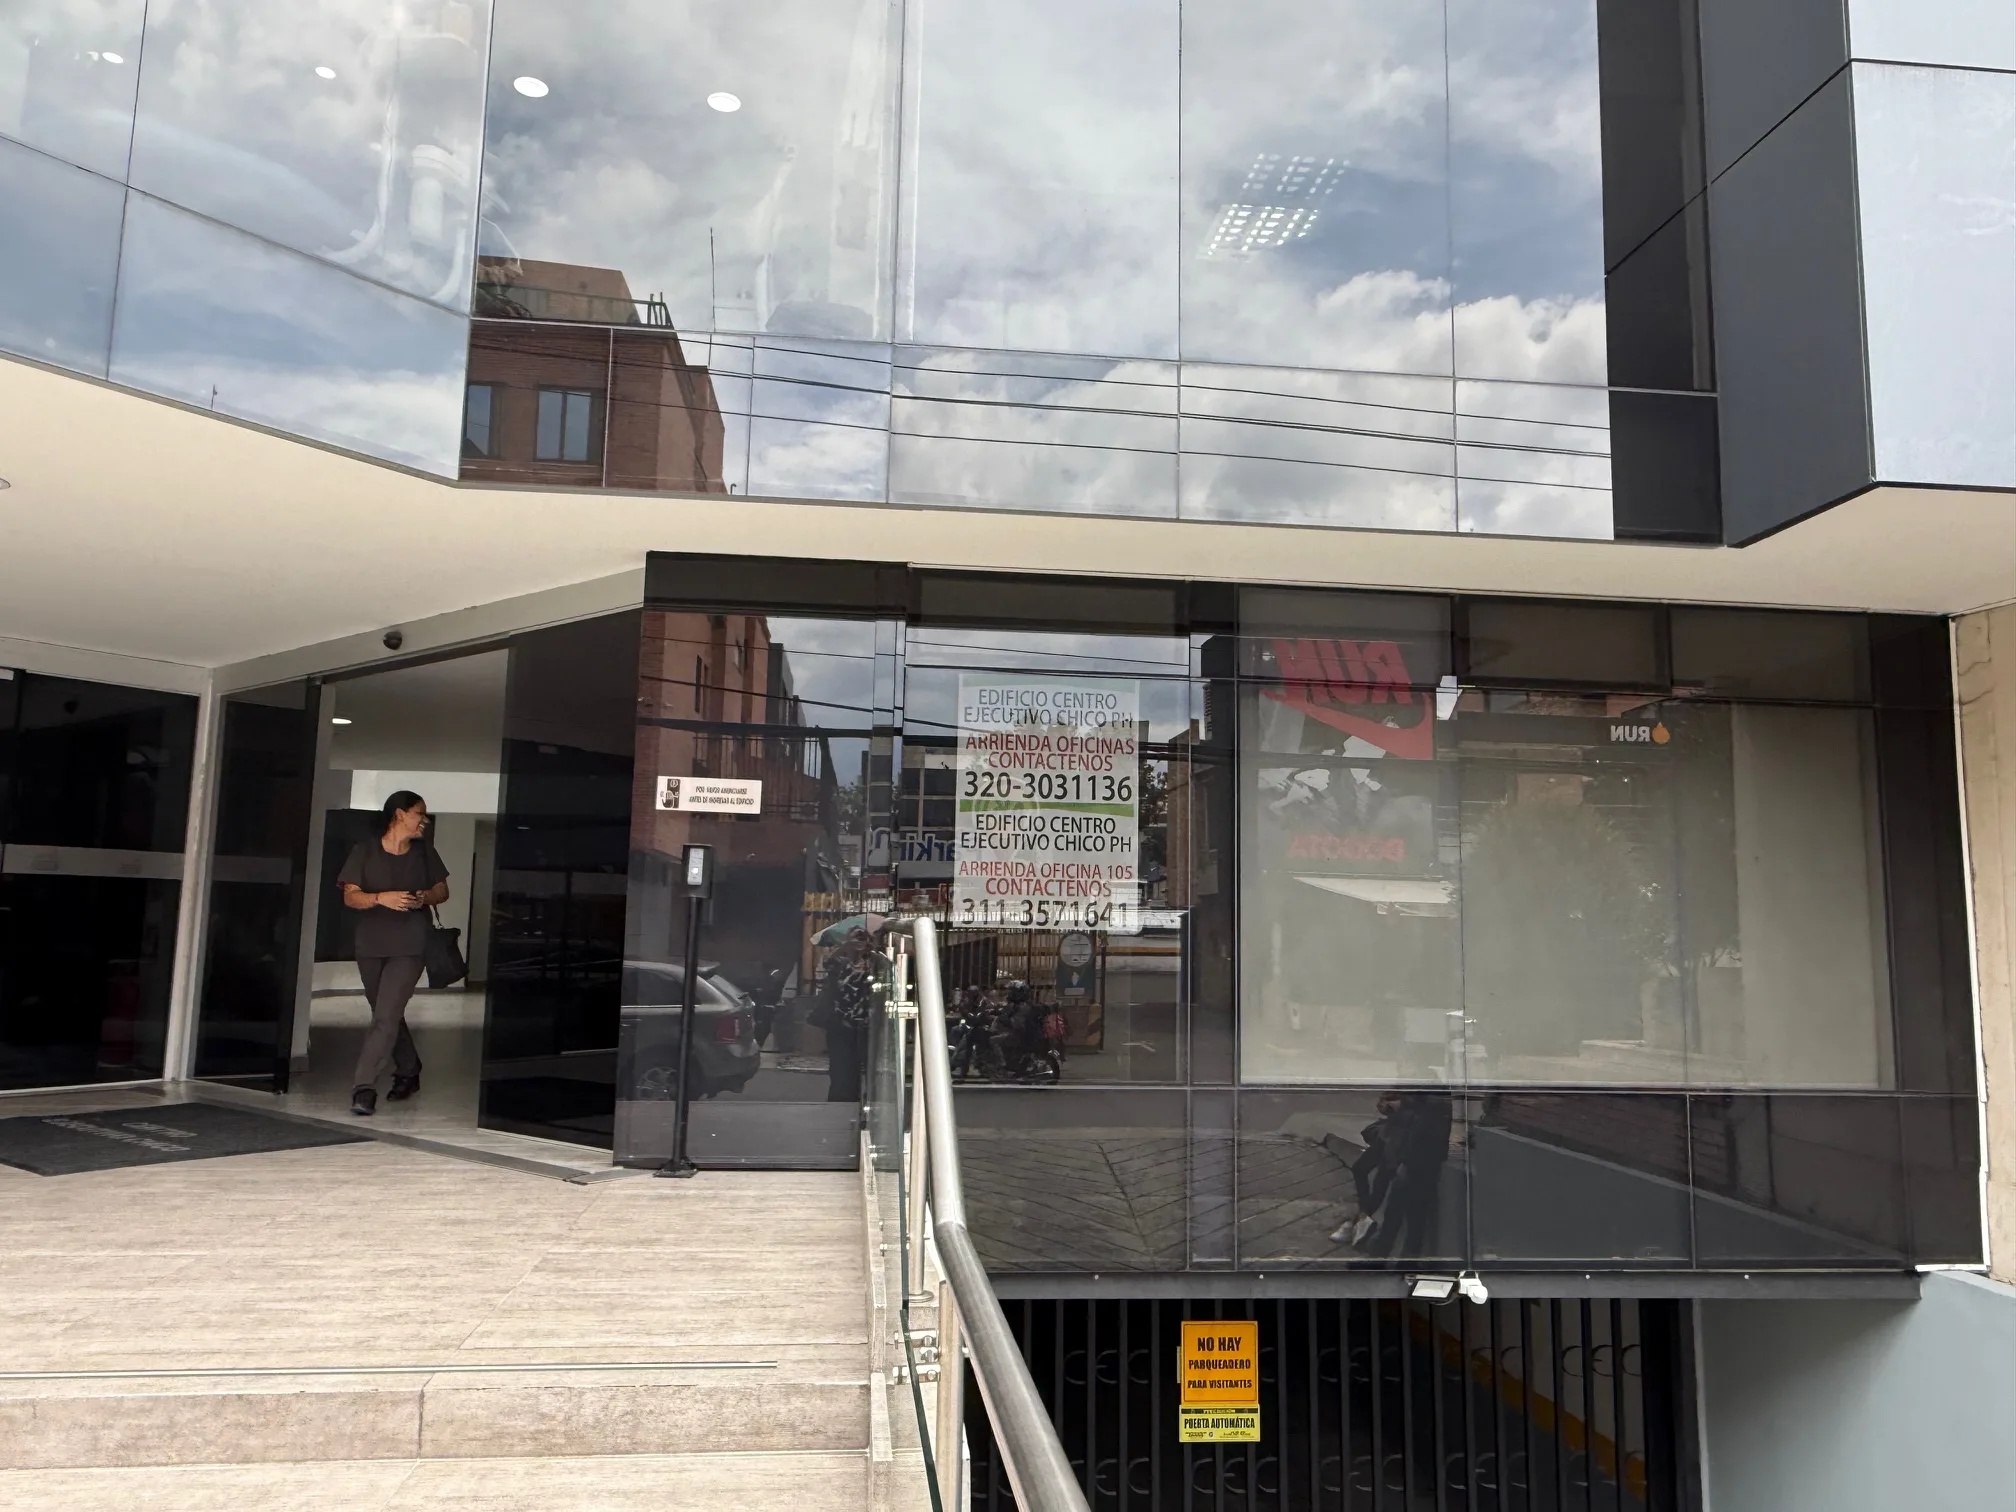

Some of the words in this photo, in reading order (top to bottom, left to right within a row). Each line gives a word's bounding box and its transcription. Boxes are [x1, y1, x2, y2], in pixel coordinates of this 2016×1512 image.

[978, 689, 1048, 707] EDIFICIO
[1052, 691, 1117, 710] CENTRO
[963, 706, 1051, 726] EJECUTIVO
[1056, 710, 1107, 728] CHICO
[1111, 712, 1134, 729] PH
[965, 733, 1051, 752] ARRIENDA
[1056, 735, 1135, 755] OFICINAS
[988, 752, 1114, 771] CONTACTENOS
[964, 771, 1133, 801] 320-3031136
[975, 814, 1046, 833] EDIFICIO
[1050, 816, 1116, 834] CENTRO
[961, 832, 1049, 851] EJECUTIVO
[1054, 834, 1106, 852] CHICO
[1110, 836, 1132, 853] PH
[959, 860, 1037, 878] ARRIENDA
[1040, 862, 1102, 880] OFICINA
[1107, 865, 1133, 880] 105
[985, 877, 1112, 897] CONTACTENOS
[1197, 1337, 1215, 1352] NO
[1218, 1337, 1242, 1352] HAY
[1188, 1359, 1251, 1370] PARQUEADERO
[1188, 1380, 1207, 1389] PARA
[1209, 1379, 1252, 1389] VISITANTES
[1184, 1418, 1211, 1429] PUERTA
[1211, 1416, 1255, 1429] AUTOMÁTICA
